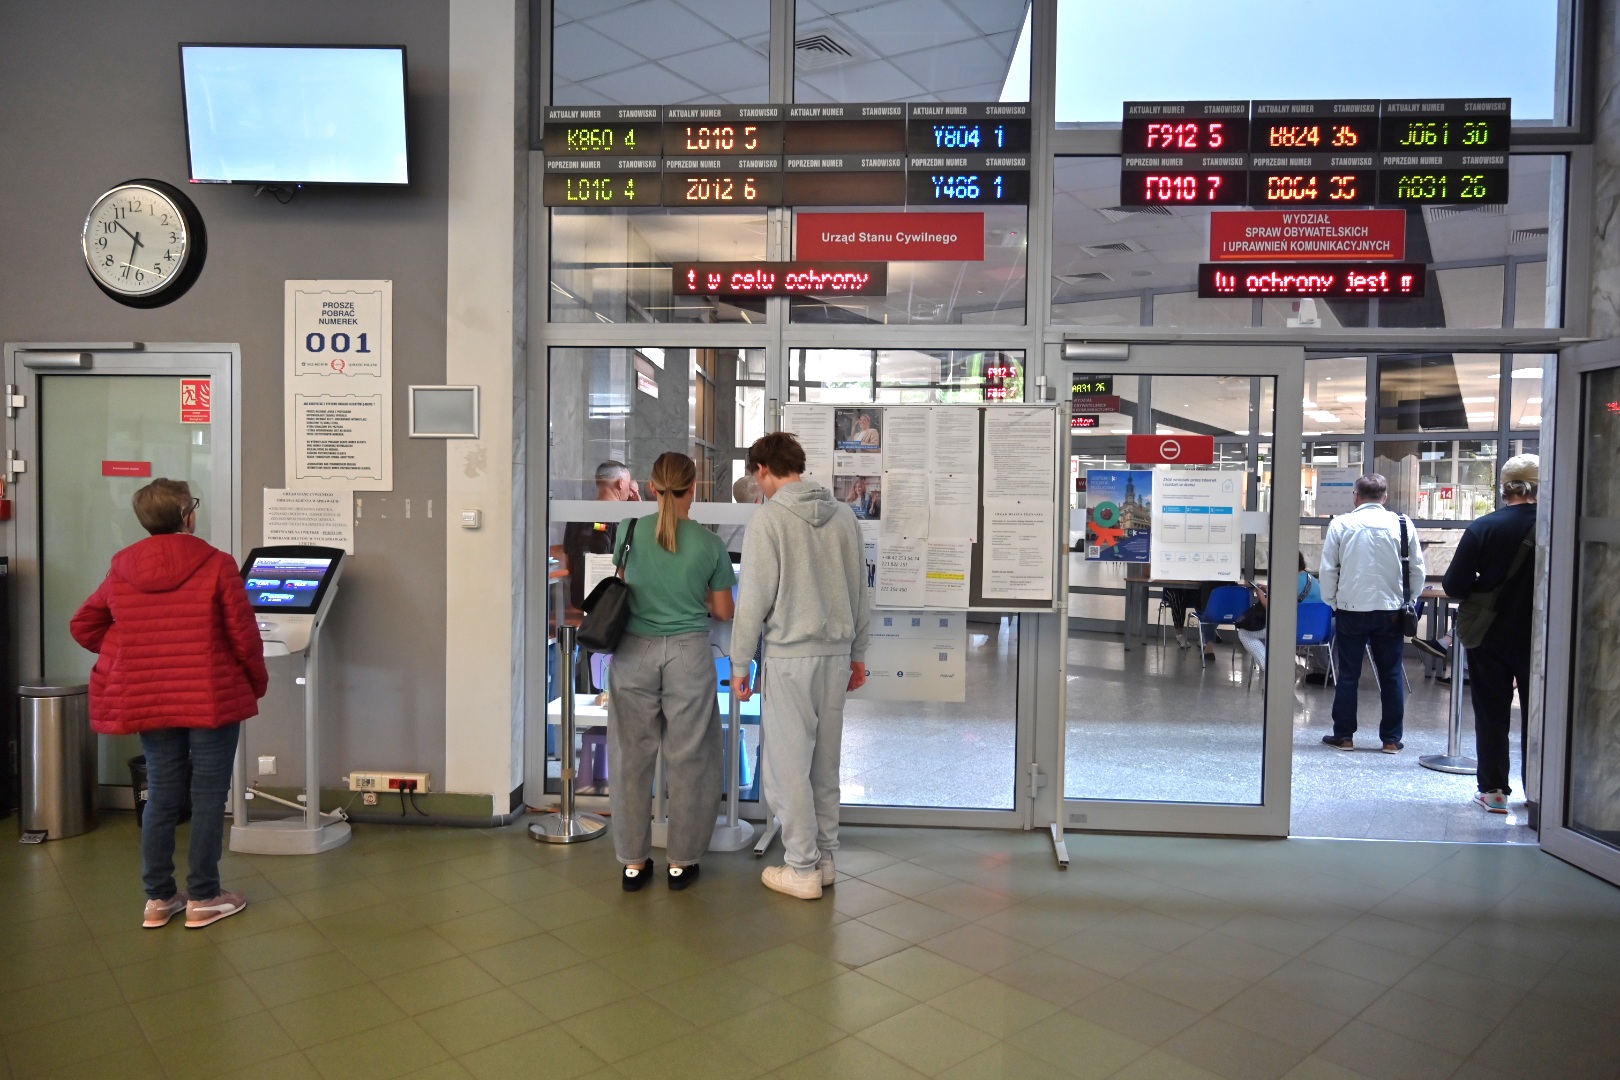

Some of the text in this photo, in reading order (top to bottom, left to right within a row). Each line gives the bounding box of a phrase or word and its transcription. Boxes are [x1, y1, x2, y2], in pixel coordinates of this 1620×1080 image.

[668, 108, 778, 118] AKTUALNY NUMER STANOWISKO
[790, 107, 901, 116] AKTUALNY NUMER STANOWISKO
[913, 106, 1026, 115] AKTUALNY NUMER STANOWISKO
[1129, 106, 1161, 114] AKTUALNY
[1204, 105, 1245, 114] STANOWISKO
[1258, 104, 1375, 113] AKTUALNY NUMER STANOWISKO
[1388, 102, 1506, 112] AKTUALNY NUMER STANOWISKO
[550, 110, 656, 118] AKTUALNY NUMER STANOWISKO
[624, 128, 636, 150] 4
[744, 127, 756, 150] 5
[994, 126, 1003, 148] 1
[1147, 124, 1222, 148] F912 5
[1462, 122, 1488, 144] 30
[581, 160, 600, 168] NUMER
[619, 160, 656, 168] STANOWISKO
[666, 160, 698, 168] POPRZEDNI
[739, 160, 778, 168] STANOWISKO
[788, 159, 900, 168] POPRZEDNI NUMER STANOWISKO
[911, 158, 1026, 166] POPRZEDNI NUMER STANOWISKO
[1126, 158, 1243, 166] POPRZEDNI NUMER STANOWISKO
[1254, 158, 1288, 166] POPRZEDNI
[1331, 158, 1372, 166] STANOWISKO
[1384, 156, 1504, 165] POPRZEDNI NUMER STANOWISKO
[624, 178, 634, 200] 4
[744, 178, 756, 200] 6
[994, 176, 1002, 198] 1
[1208, 176, 1220, 200] 7
[128, 200, 142, 212] 12
[150, 204, 154, 216] 1
[114, 206, 126, 220] 11
[1283, 214, 1330, 224] WYDZIAŁ
[160, 214, 169, 226] 2
[104, 222, 117, 234] 10
[1246, 226, 1368, 238] SPRAW OBYWATELSKICH
[98, 236, 108, 250] 9
[168, 232, 176, 244] 3
[822, 232, 958, 244] Urząd Stanu Cywilnego
[1223, 239, 1390, 252] I UPRAWNIEŃ KOMUNIKACYJNYCH
[105, 254, 114, 266] 8
[164, 249, 172, 261] 4
[120, 265, 127, 278] 7
[154, 262, 162, 274] 5
[135, 268, 144, 282] 6
[708, 274, 721, 290] w
[730, 270, 775, 290] celu
[784, 270, 869, 290] ochrony
[1246, 271, 1334, 292] ochrony
[1346, 271, 1389, 292] jest
[322, 302, 354, 310] PROSZĘ
[322, 309, 355, 317] POBRAĆ
[306, 332, 372, 353] 001
[1442, 490, 1452, 499] 14
